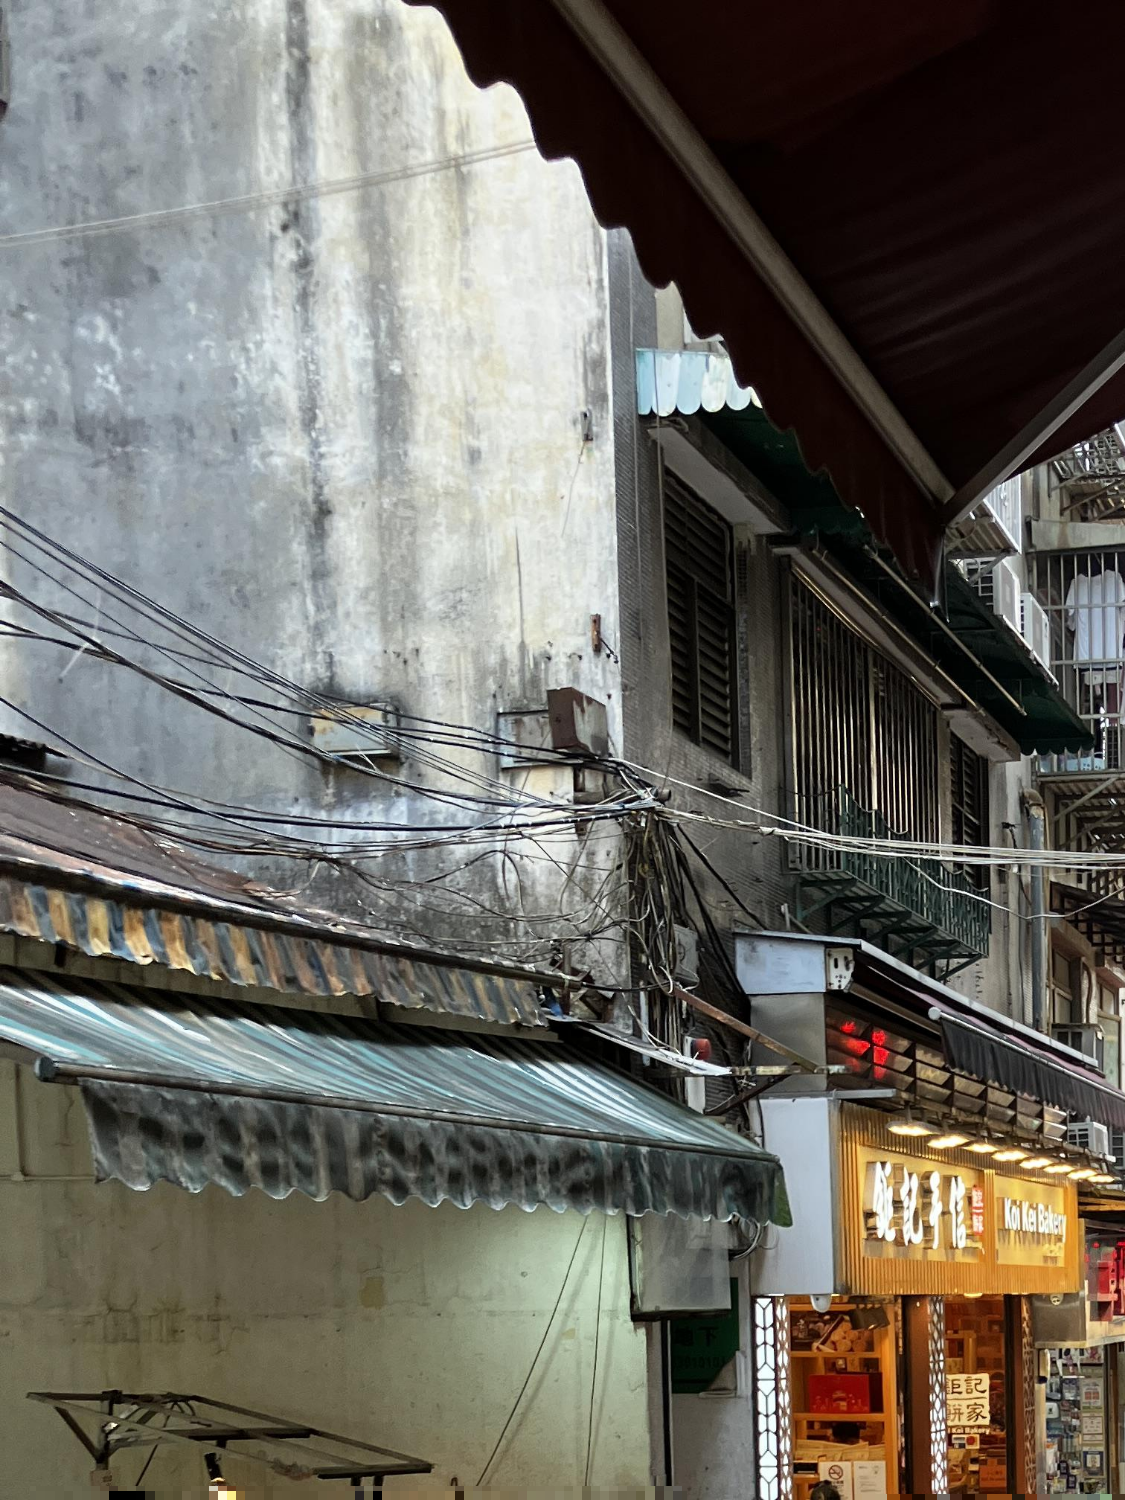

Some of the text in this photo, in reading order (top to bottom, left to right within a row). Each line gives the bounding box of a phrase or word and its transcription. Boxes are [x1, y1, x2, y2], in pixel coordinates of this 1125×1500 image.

[1004, 1198, 1020, 1230] Koi
[1022, 1201, 1037, 1232] Kei
[1038, 1203, 1066, 1243] Bakery
